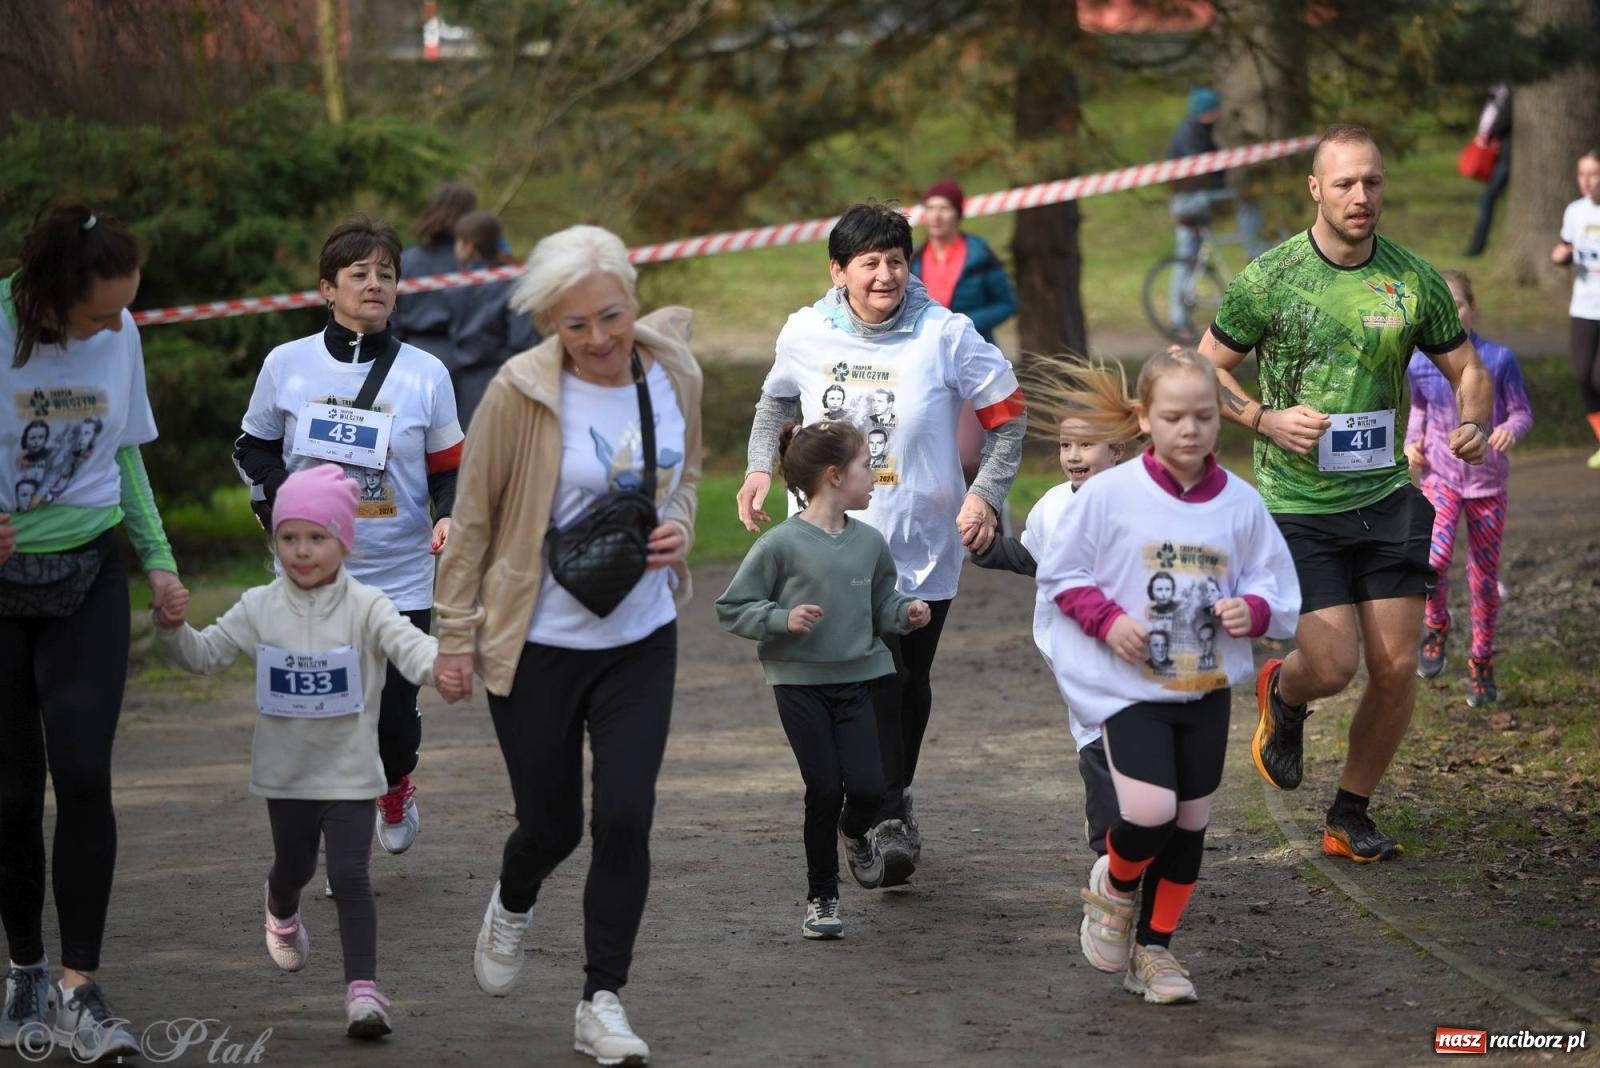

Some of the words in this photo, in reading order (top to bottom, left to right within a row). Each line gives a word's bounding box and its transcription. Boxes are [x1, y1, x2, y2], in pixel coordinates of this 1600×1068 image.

[851, 371, 889, 380] WILCZYM
[339, 414, 365, 422] WILCZYM
[1357, 419, 1377, 427] WILCZYM
[328, 423, 357, 444] 43
[1350, 429, 1372, 450] 41
[284, 671, 333, 694] 133
